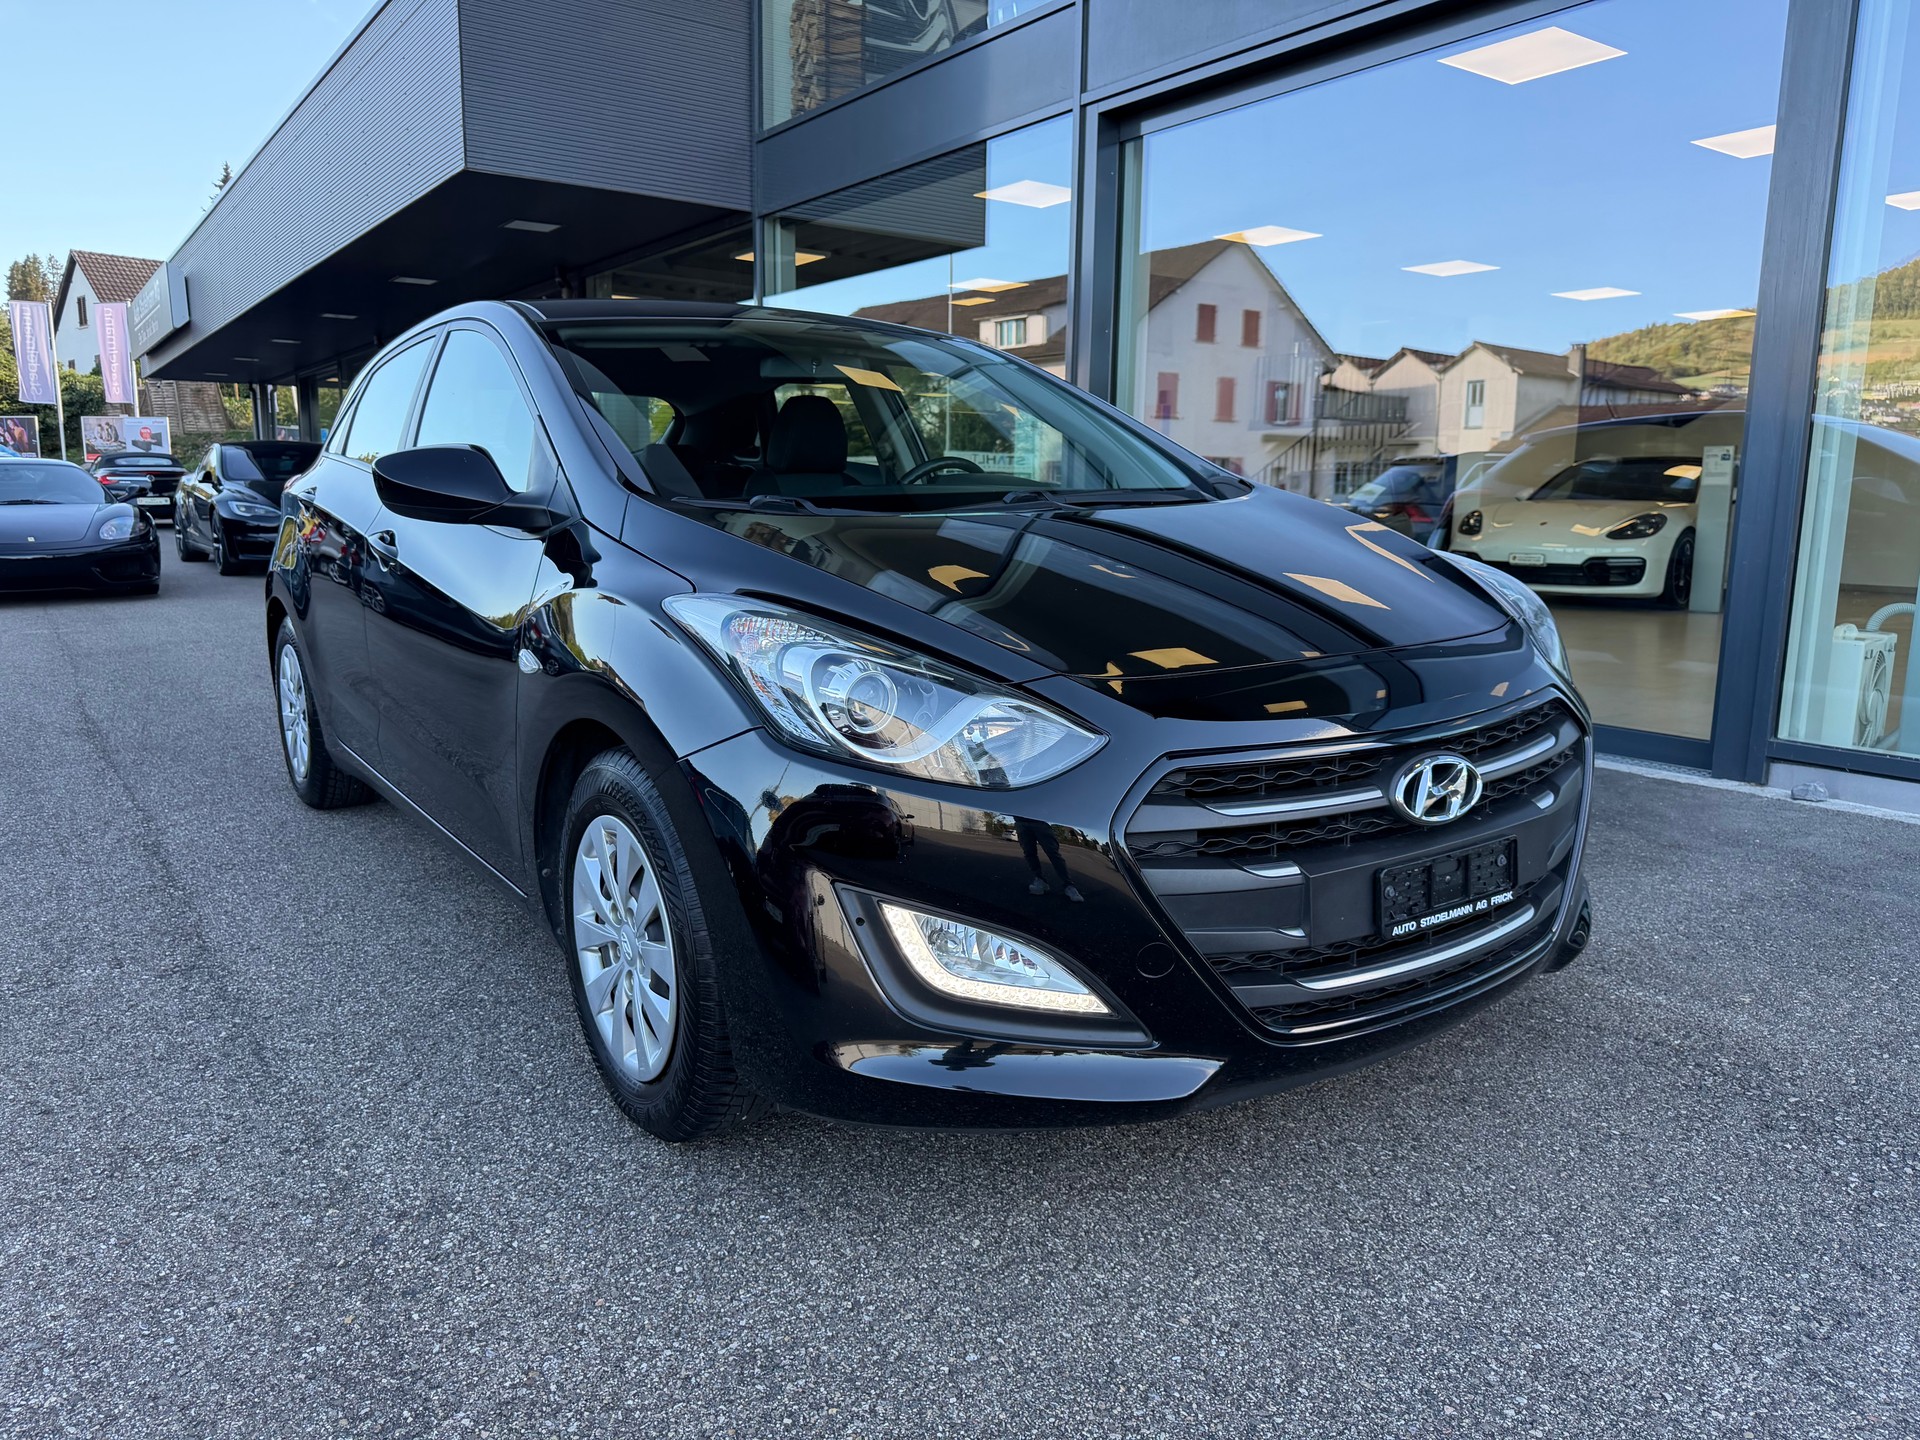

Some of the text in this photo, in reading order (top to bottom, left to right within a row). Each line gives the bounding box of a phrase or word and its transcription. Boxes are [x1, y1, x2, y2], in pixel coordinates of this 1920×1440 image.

[1392, 891, 1513, 935] AUTO STADELMANN AG FRICK
